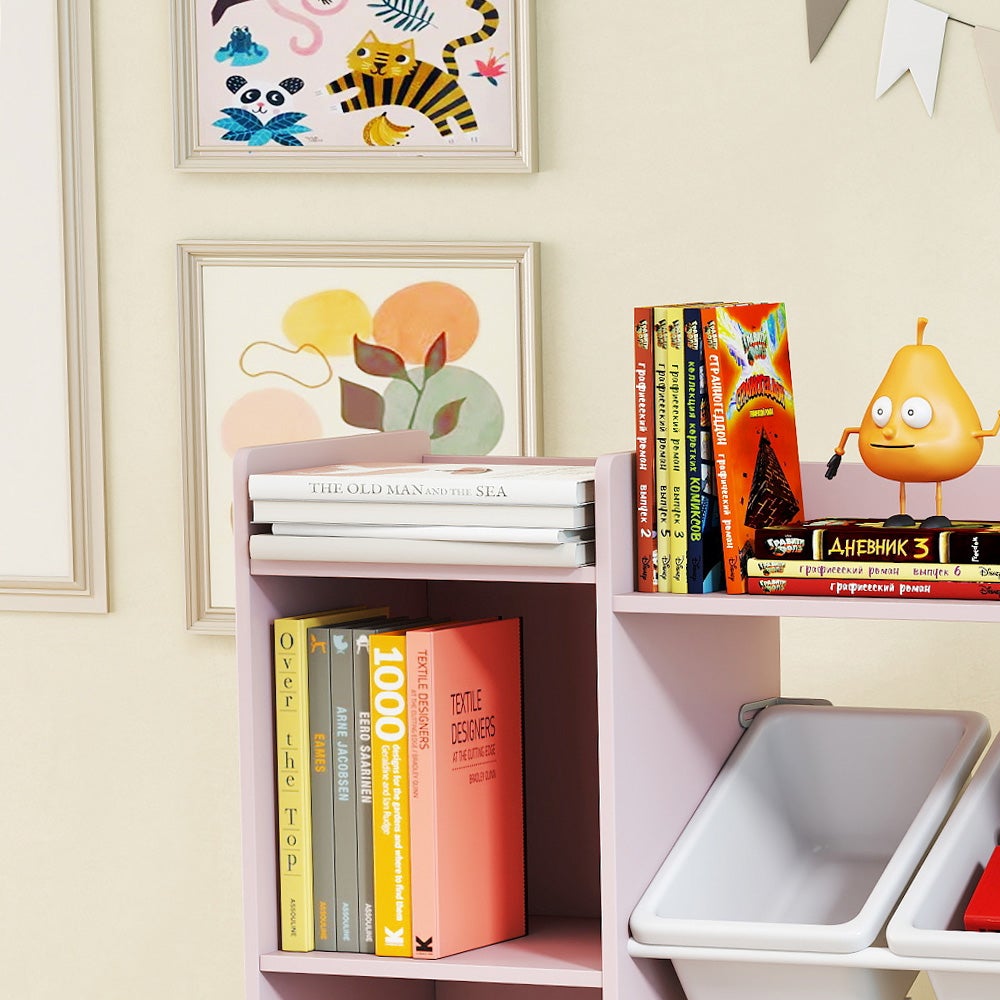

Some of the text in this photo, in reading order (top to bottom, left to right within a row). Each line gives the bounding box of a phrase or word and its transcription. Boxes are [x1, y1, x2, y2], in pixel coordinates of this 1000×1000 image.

[638, 435, 647, 471] роман
[659, 437, 667, 472] роман
[672, 438, 681, 472] роман
[687, 361, 702, 542] коллекция коротких КОМИКСОВ
[708, 354, 734, 549] СТРАННОГЕДДОН графический роман
[308, 482, 508, 498] THE OLD MAN AND THE SEA
[639, 484, 648, 523] выпуск
[660, 485, 668, 523] выпуск
[673, 486, 681, 524] выпуск
[640, 529, 652, 538] 2
[660, 530, 671, 538] 5
[673, 530, 684, 538] 3
[828, 537, 930, 559] ДНЕВНИК 3
[641, 555, 650, 580] Disney
[661, 555, 671, 580] Disney
[675, 556, 685, 581] Disney
[728, 556, 737, 581] Disney
[869, 566, 900, 577] роман
[913, 568, 949, 579] выпуск
[953, 565, 961, 576] 6
[899, 584, 931, 596] роман
[373, 647, 406, 741] 1000
[410, 698, 418, 709] THE
[417, 650, 430, 750] TEXTILE DESIGNERS
[450, 689, 482, 716] TEXTILE
[451, 716, 496, 745] DESIGNERS
[280, 632, 298, 873] Over the Top
[313, 733, 327, 773] EAMES
[336, 706, 350, 802] ARNE JACOBSEN
[359, 711, 372, 804] EERO SAARINEN
[452, 751, 459, 764] AT
[458, 750, 467, 762] THE
[485, 744, 496, 757] EDGE
[381, 745, 392, 835] Geraldine and Ian Rudge
[391, 744, 405, 922] designs for the gardens and where to find them
[341, 902, 351, 942] ASSOULINE
[364, 903, 373, 943] ASSOULINE
